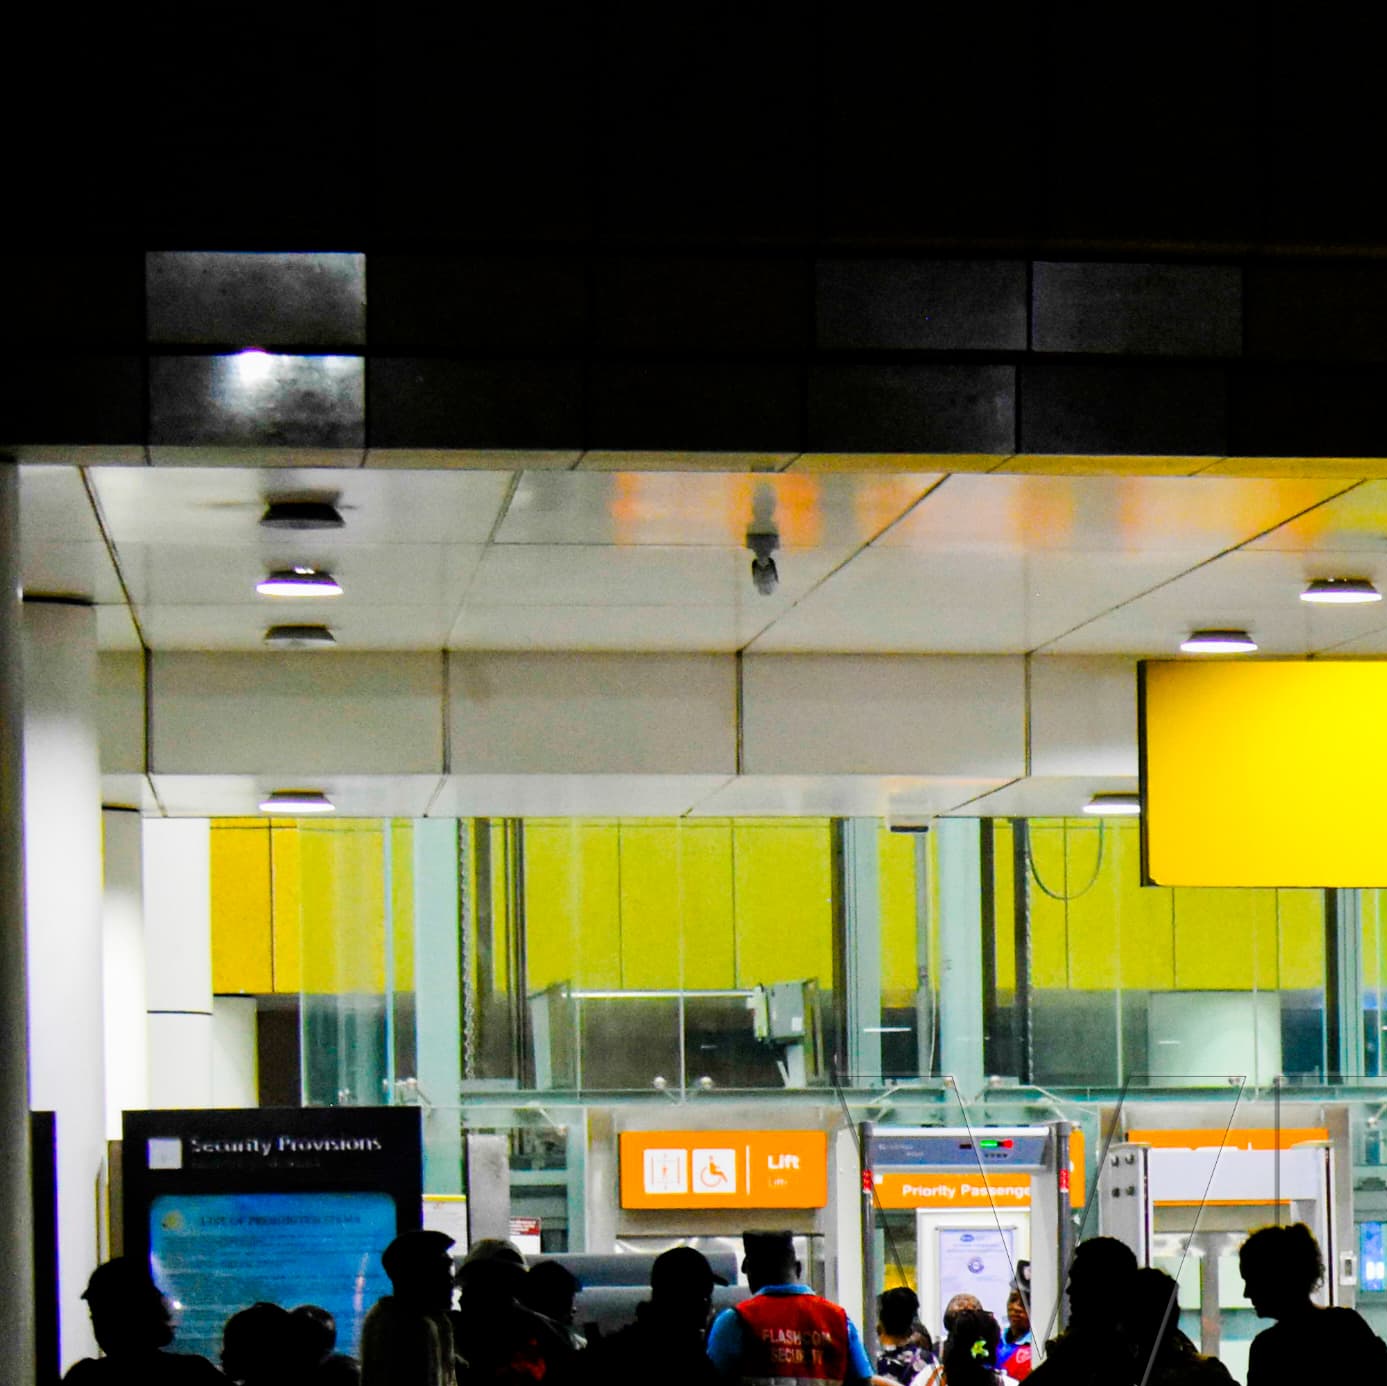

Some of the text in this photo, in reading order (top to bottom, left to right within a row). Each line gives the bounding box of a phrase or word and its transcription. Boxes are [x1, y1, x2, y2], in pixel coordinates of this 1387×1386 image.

[191, 1133, 382, 1157] Security Provisions
[767, 1153, 800, 1169] Lift
[902, 1184, 955, 1199] Priority
